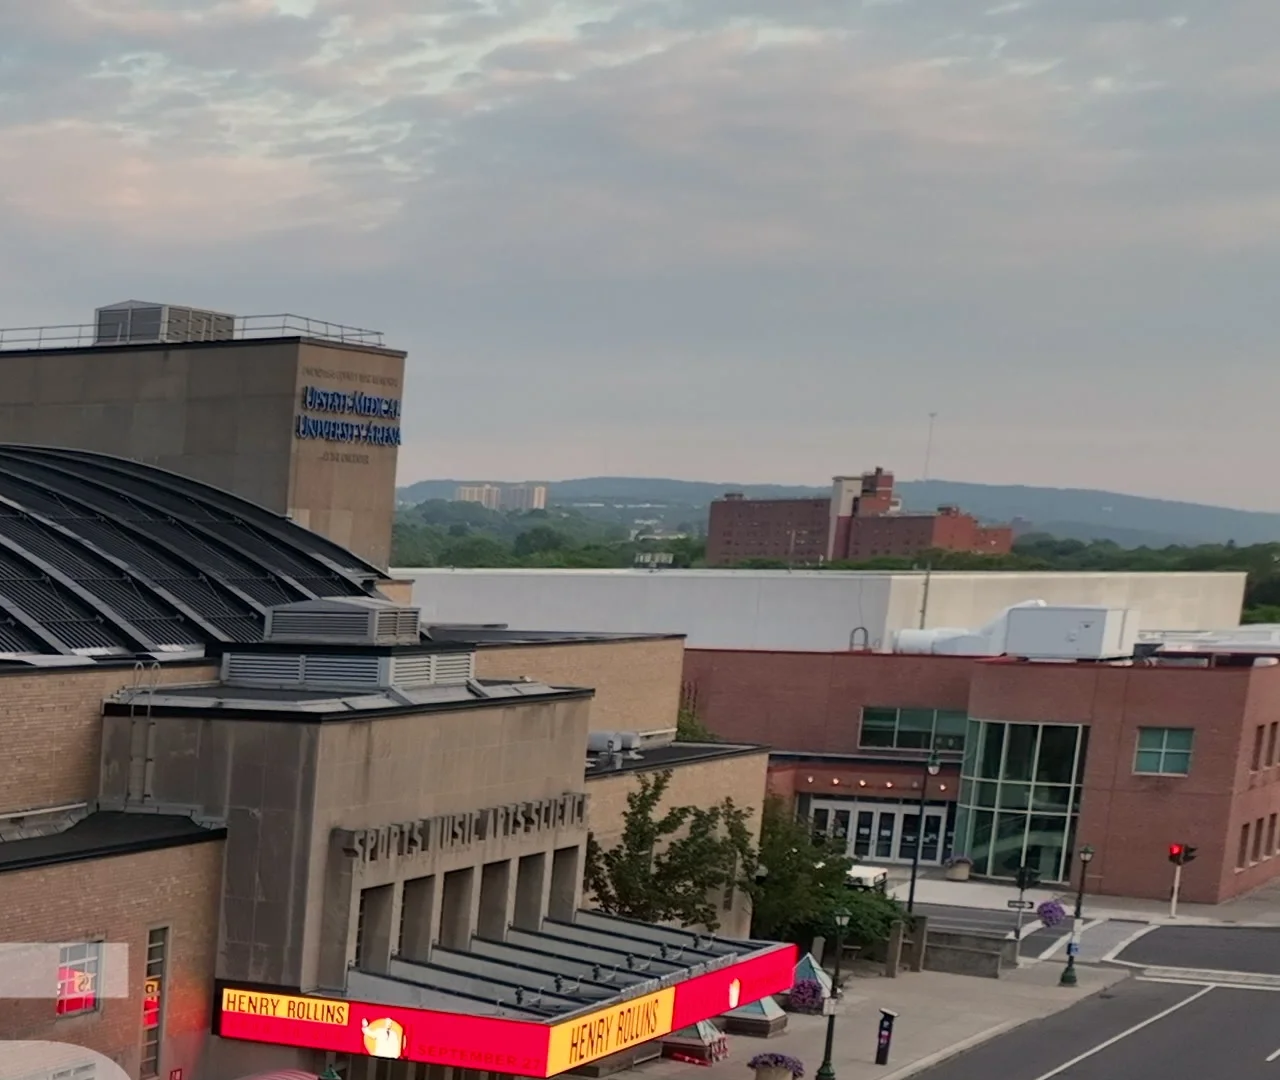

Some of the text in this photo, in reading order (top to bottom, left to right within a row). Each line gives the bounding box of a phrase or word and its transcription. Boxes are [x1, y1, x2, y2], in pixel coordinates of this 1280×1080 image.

[302, 386, 401, 419] UPSTATE MEDICAL
[295, 415, 402, 447] UNIVERSITY ARENA
[226, 992, 345, 1025] HENRY ROLLINS
[568, 999, 659, 1065] HENRY ROLLINS
[417, 1044, 515, 1067] SEPTEMBER
